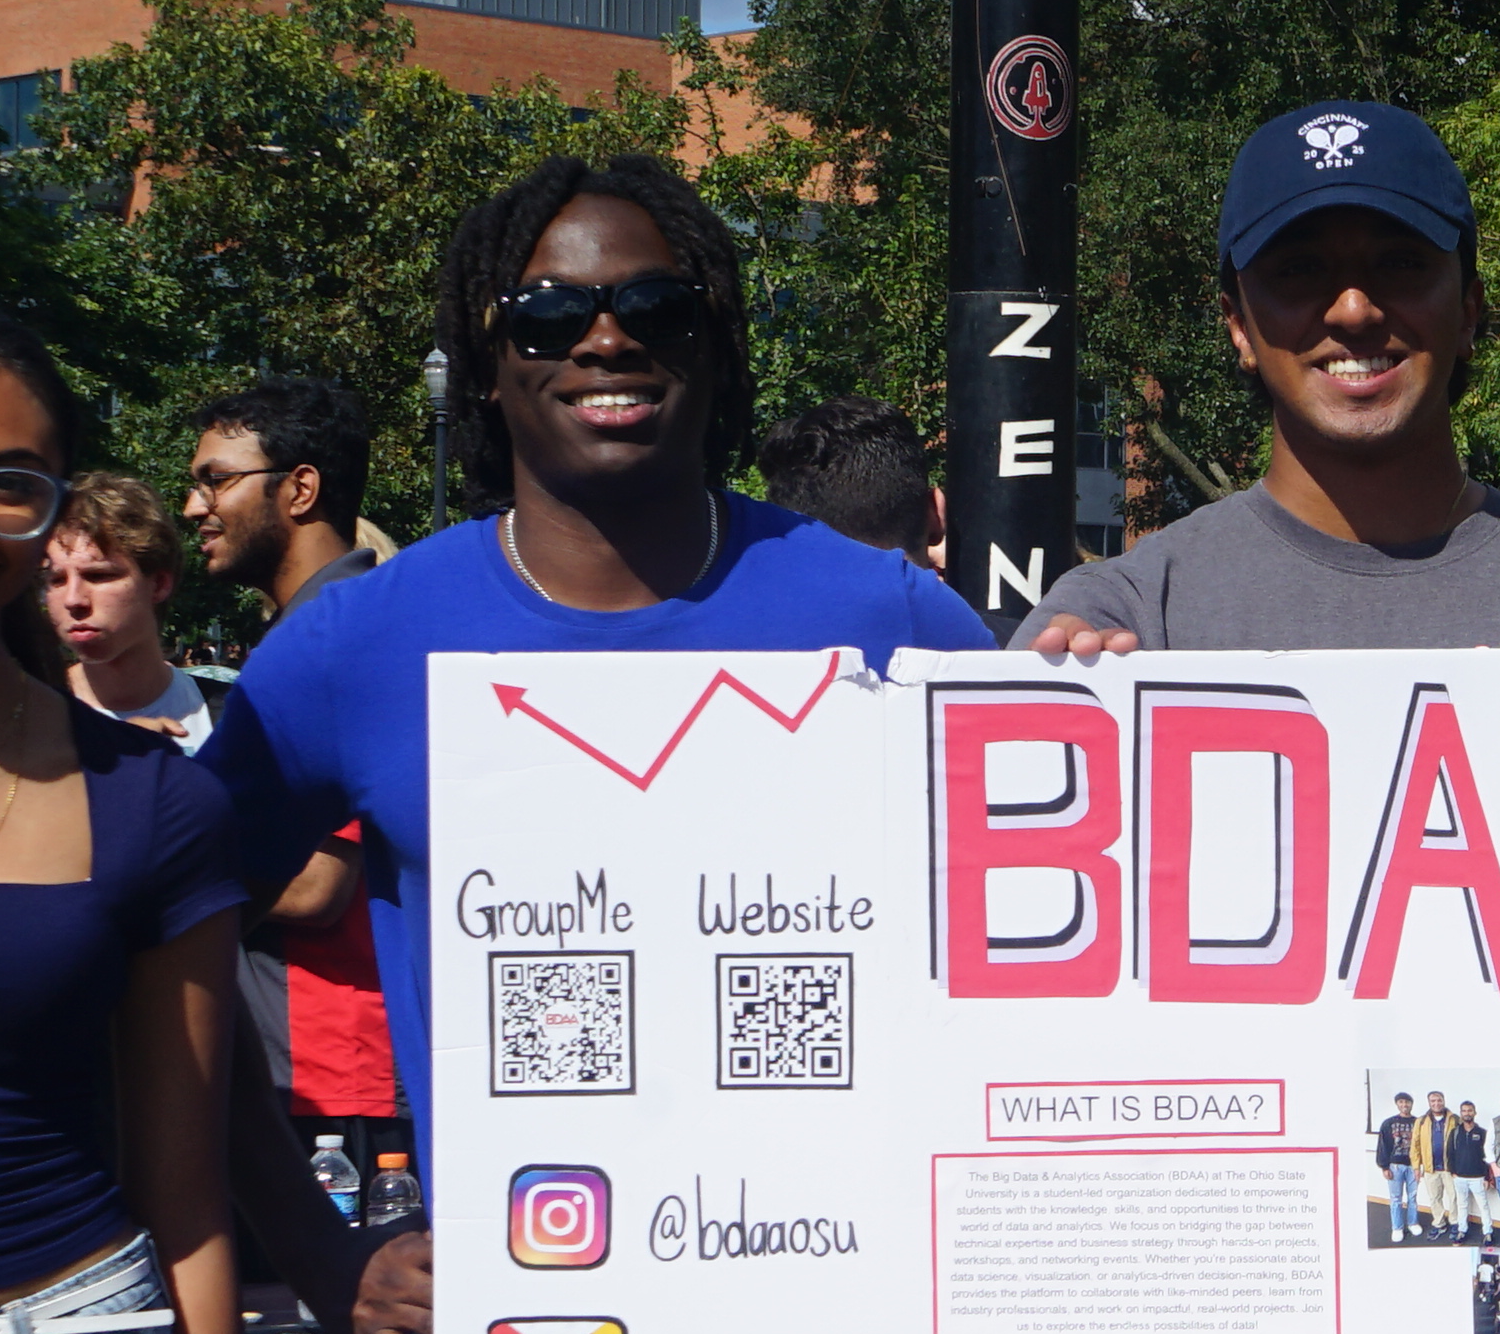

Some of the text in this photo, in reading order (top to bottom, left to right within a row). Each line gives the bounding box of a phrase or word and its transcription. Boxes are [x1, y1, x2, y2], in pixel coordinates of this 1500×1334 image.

[1316, 158, 1353, 170] OPEN
[456, 868, 634, 947] GroupMe
[699, 873, 876, 937] Website
[1001, 1094, 1264, 1122] WHAT IS BDAA?
[968, 1170, 1305, 1184] The Big Data & Analytics Association (BDAA) at The Ohio State
[648, 1174, 859, 1261] @bdaaosu
